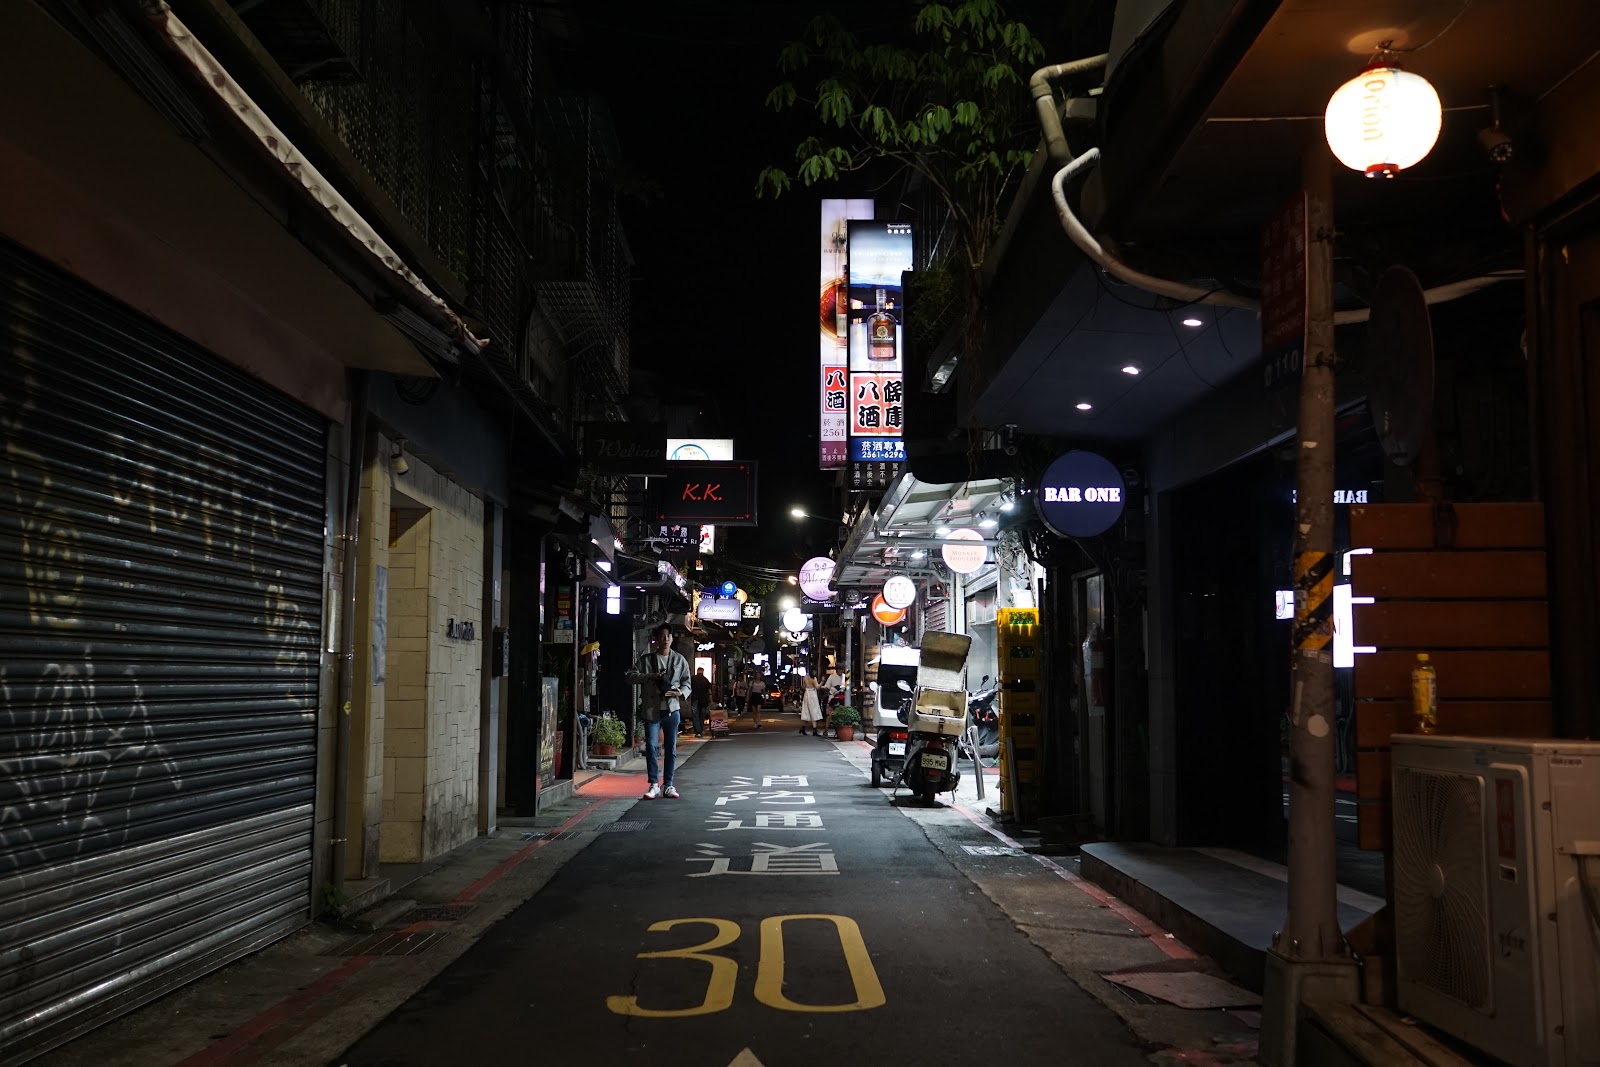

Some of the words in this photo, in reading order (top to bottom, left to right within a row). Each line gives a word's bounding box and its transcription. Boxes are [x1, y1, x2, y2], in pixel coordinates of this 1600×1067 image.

[1363, 79, 1389, 141] Orion
[861, 451, 904, 459] 2561-6296
[682, 483, 723, 501] K.K.
[1045, 487, 1081, 503] BAR
[1084, 487, 1121, 503] ONE
[606, 913, 886, 1017] 30
